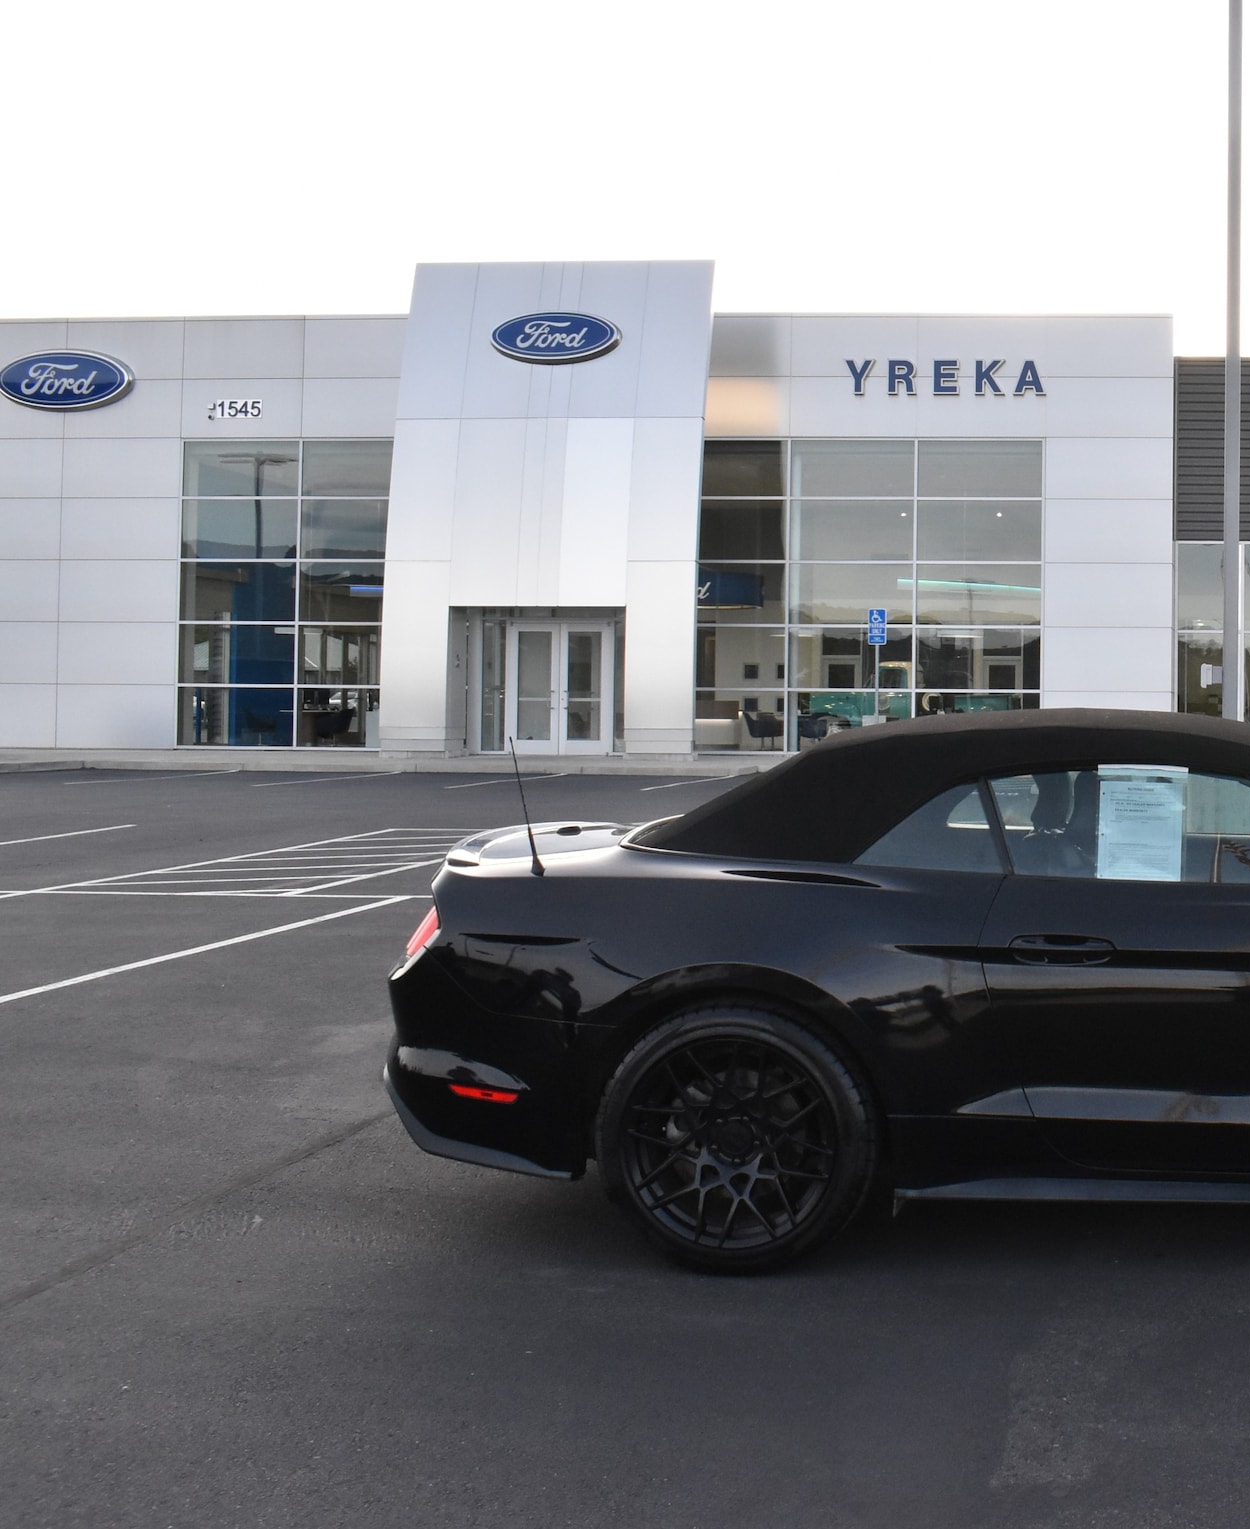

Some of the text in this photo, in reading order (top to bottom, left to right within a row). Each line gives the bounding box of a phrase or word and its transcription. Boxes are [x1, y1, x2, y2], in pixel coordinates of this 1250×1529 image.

[516, 320, 588, 348] Ford
[20, 362, 98, 395] Ford
[845, 358, 1047, 396] YREKA
[217, 400, 261, 417] 1545
